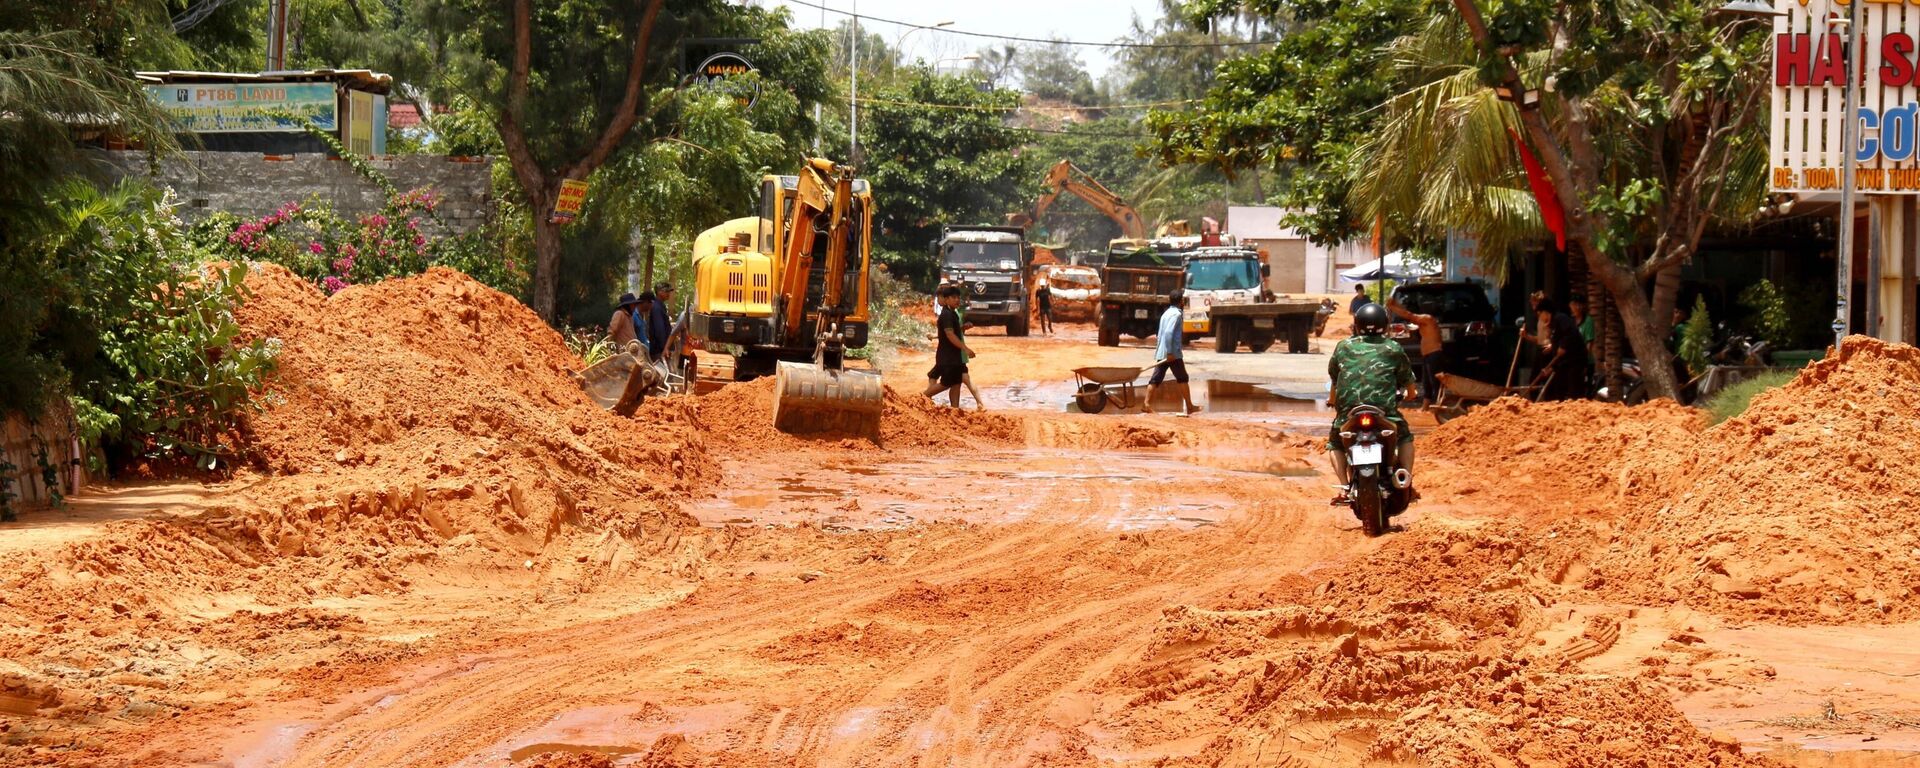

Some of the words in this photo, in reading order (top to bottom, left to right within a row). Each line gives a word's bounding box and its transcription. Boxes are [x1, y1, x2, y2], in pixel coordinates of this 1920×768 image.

[196, 88, 236, 102] PT86
[242, 87, 287, 101] LAND
[1805, 168, 1838, 189] 100A
